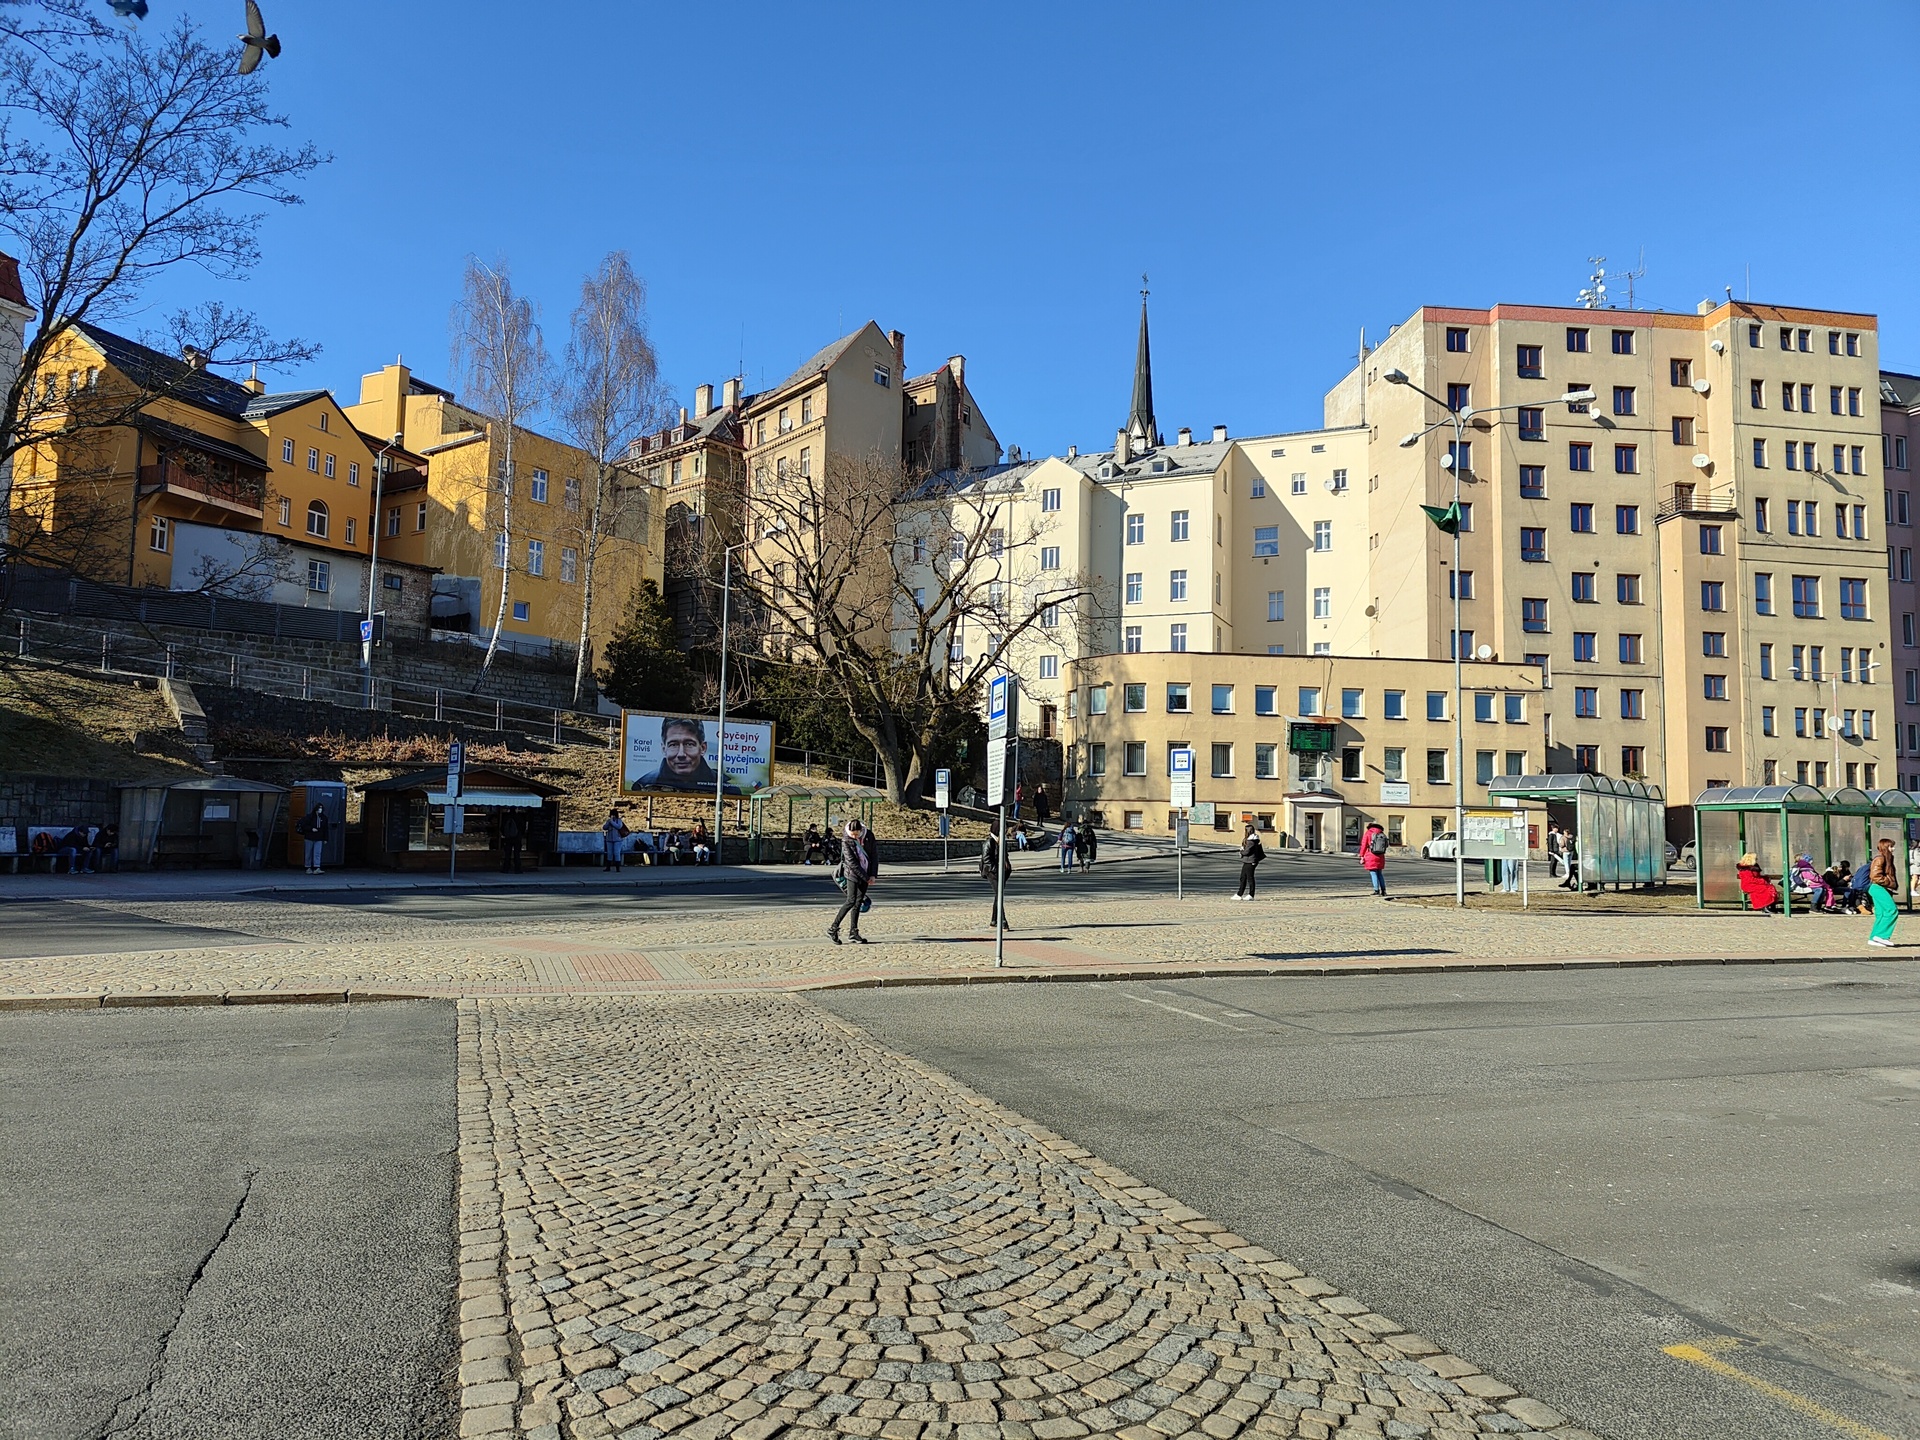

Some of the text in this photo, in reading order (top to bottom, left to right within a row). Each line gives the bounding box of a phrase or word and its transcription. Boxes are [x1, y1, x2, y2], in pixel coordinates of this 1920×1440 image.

[633, 738, 653, 746] Karel
[633, 744, 651, 752] Diviš
[741, 745, 757, 753] pro
[708, 753, 766, 765] nebyčejnou
[725, 765, 749, 774] zemi
